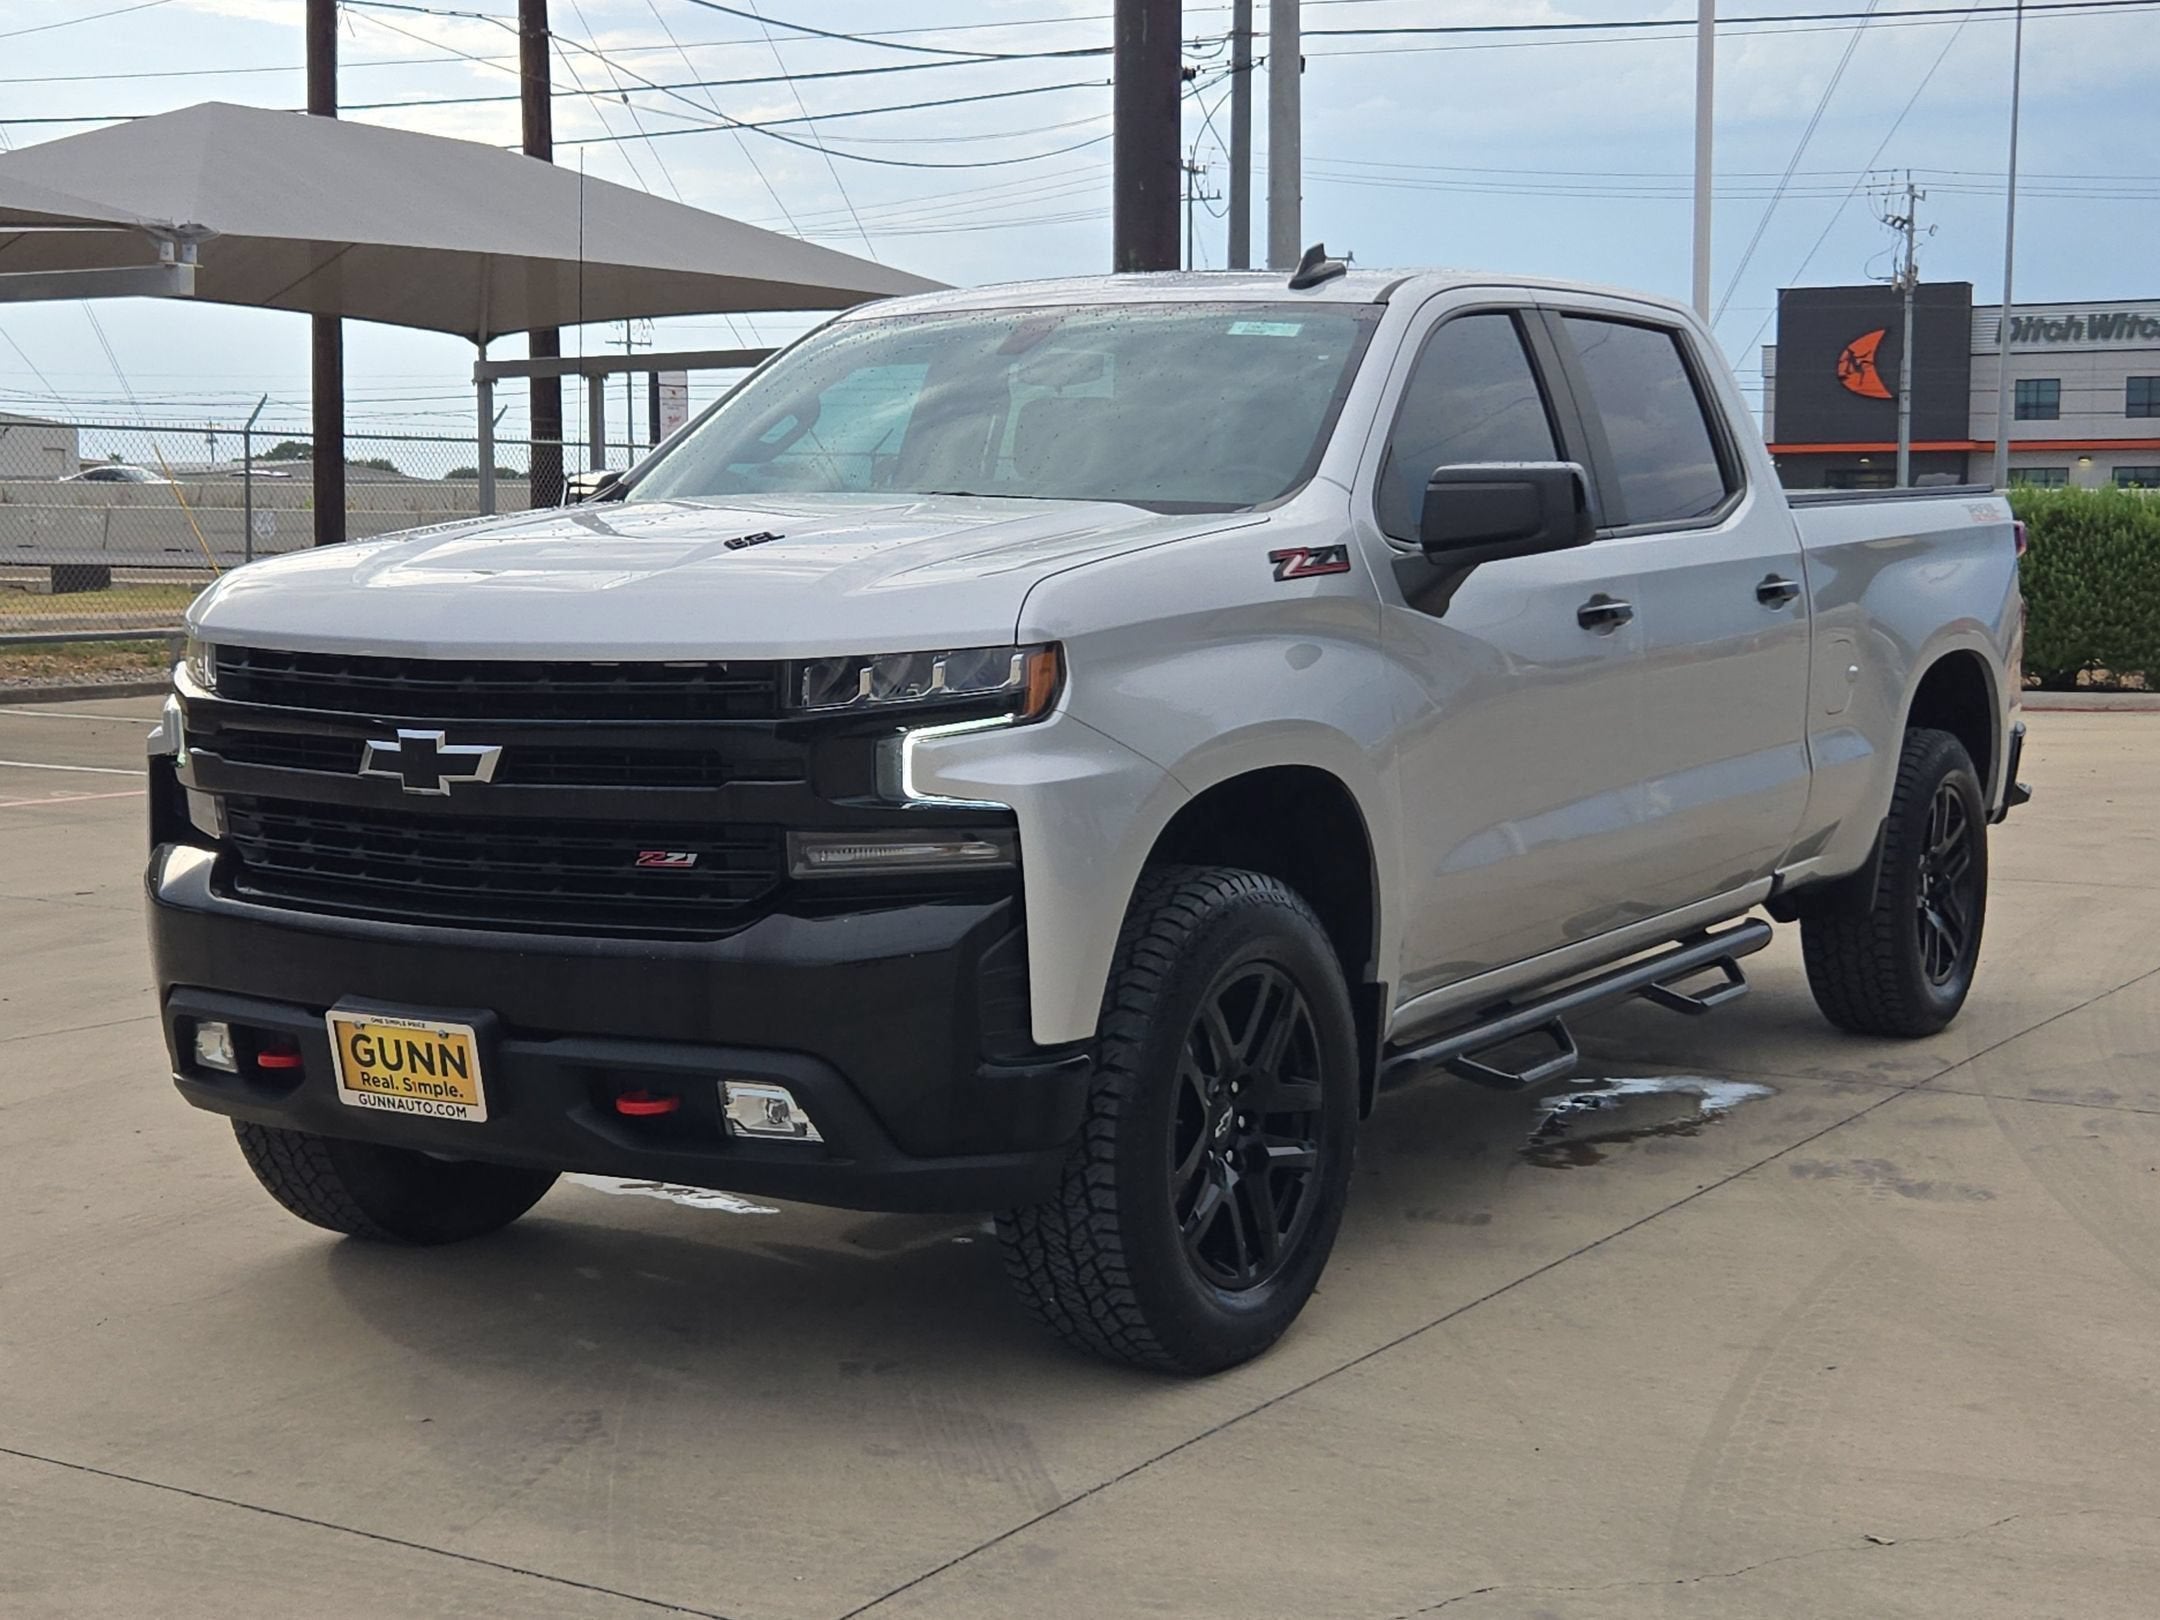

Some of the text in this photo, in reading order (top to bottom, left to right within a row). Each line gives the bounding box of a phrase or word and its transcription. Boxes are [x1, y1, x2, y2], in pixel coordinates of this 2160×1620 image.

[1995, 312, 2160, 344] Ditch Witc
[1268, 544, 1351, 582] Z71
[635, 851, 698, 867] Z71
[351, 1033, 468, 1079] GUNN
[360, 1071, 399, 1090] Real.
[358, 1094, 467, 1118] GUNNAUTO.COM
